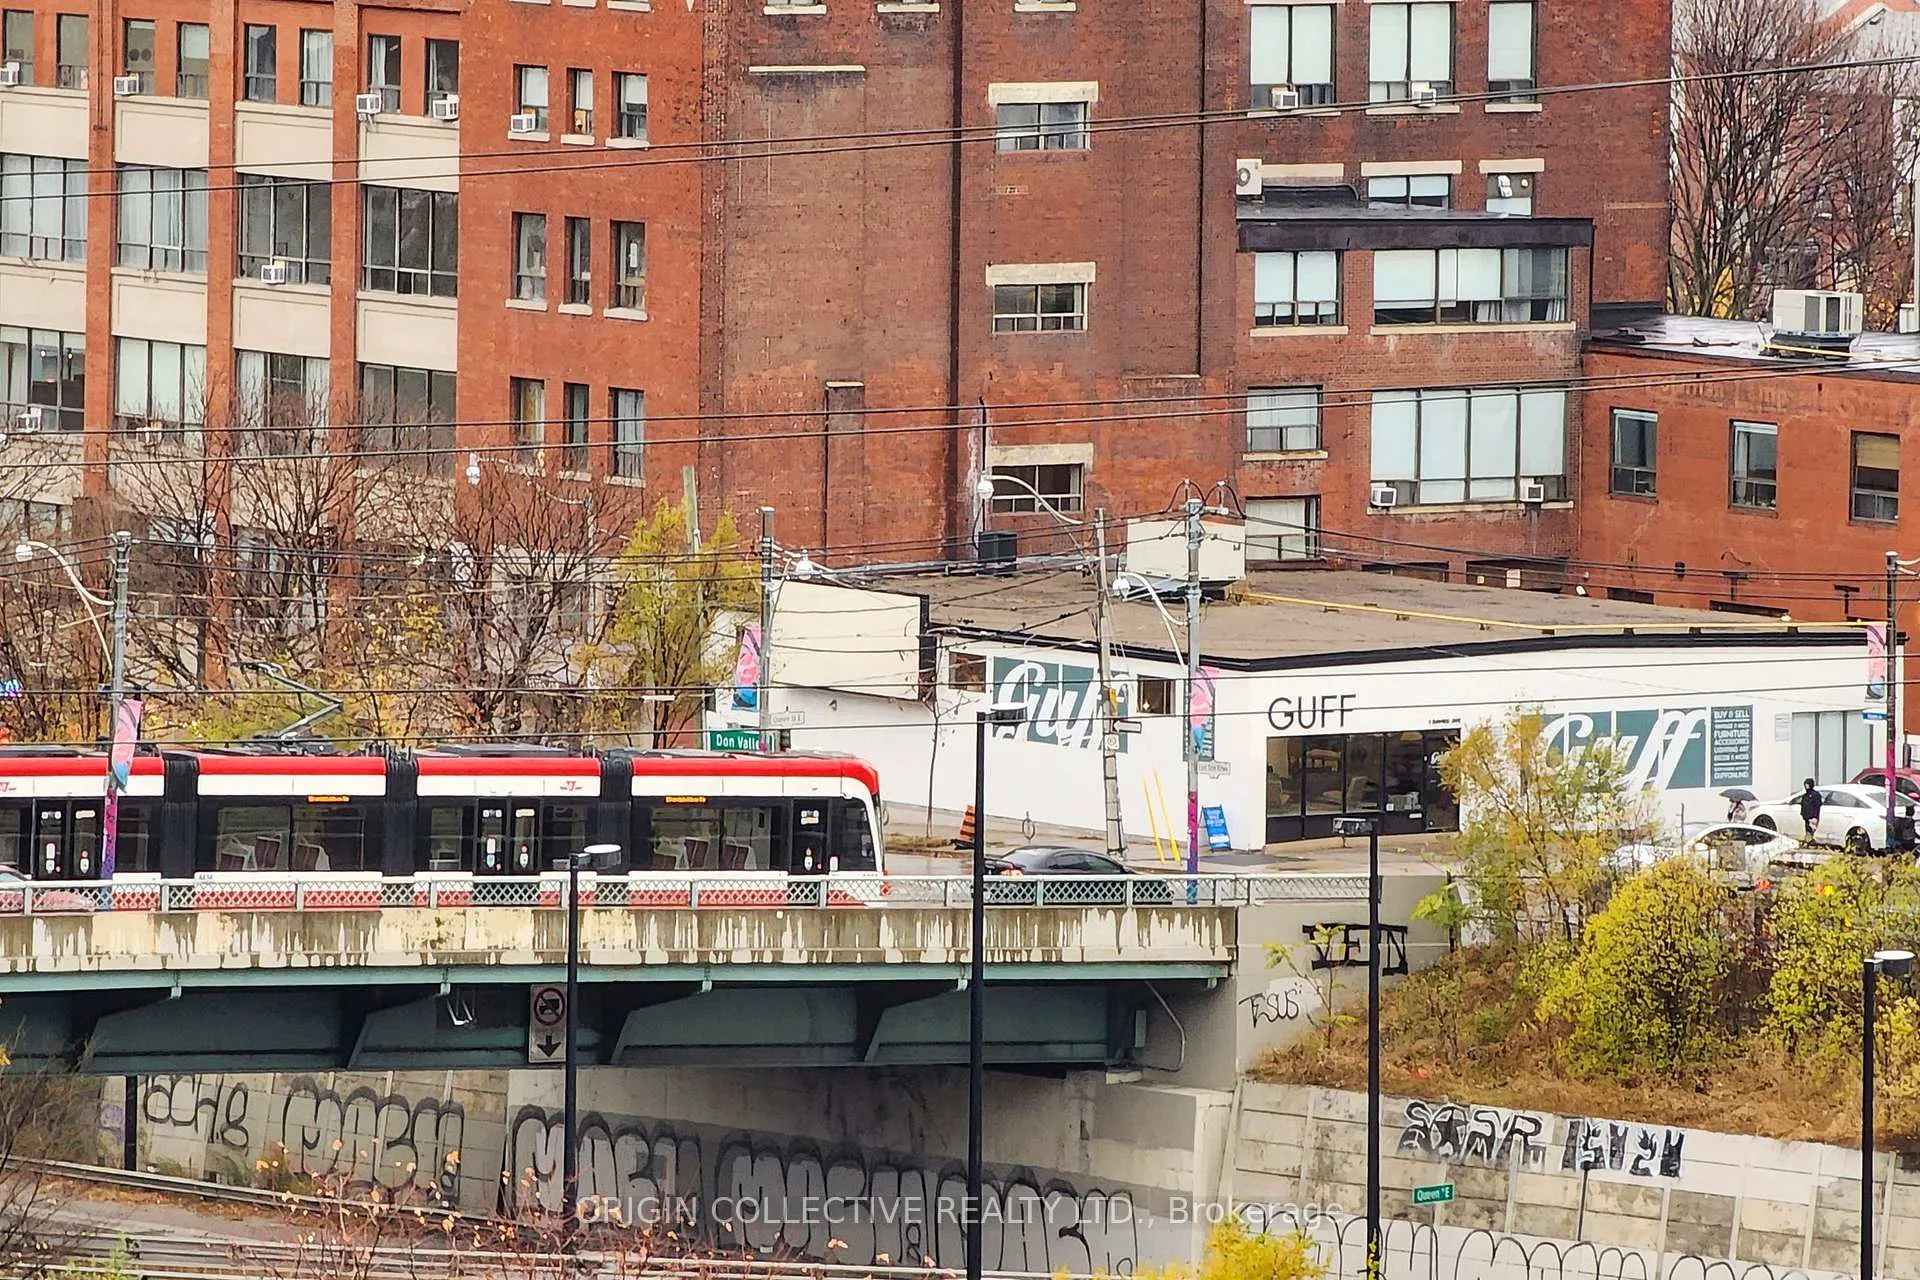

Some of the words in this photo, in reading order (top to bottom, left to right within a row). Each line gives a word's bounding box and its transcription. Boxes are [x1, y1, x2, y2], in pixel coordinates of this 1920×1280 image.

[1268, 694, 1356, 730] GUFF
[716, 734, 735, 747] Don
[1444, 1187, 1450, 1198] E
